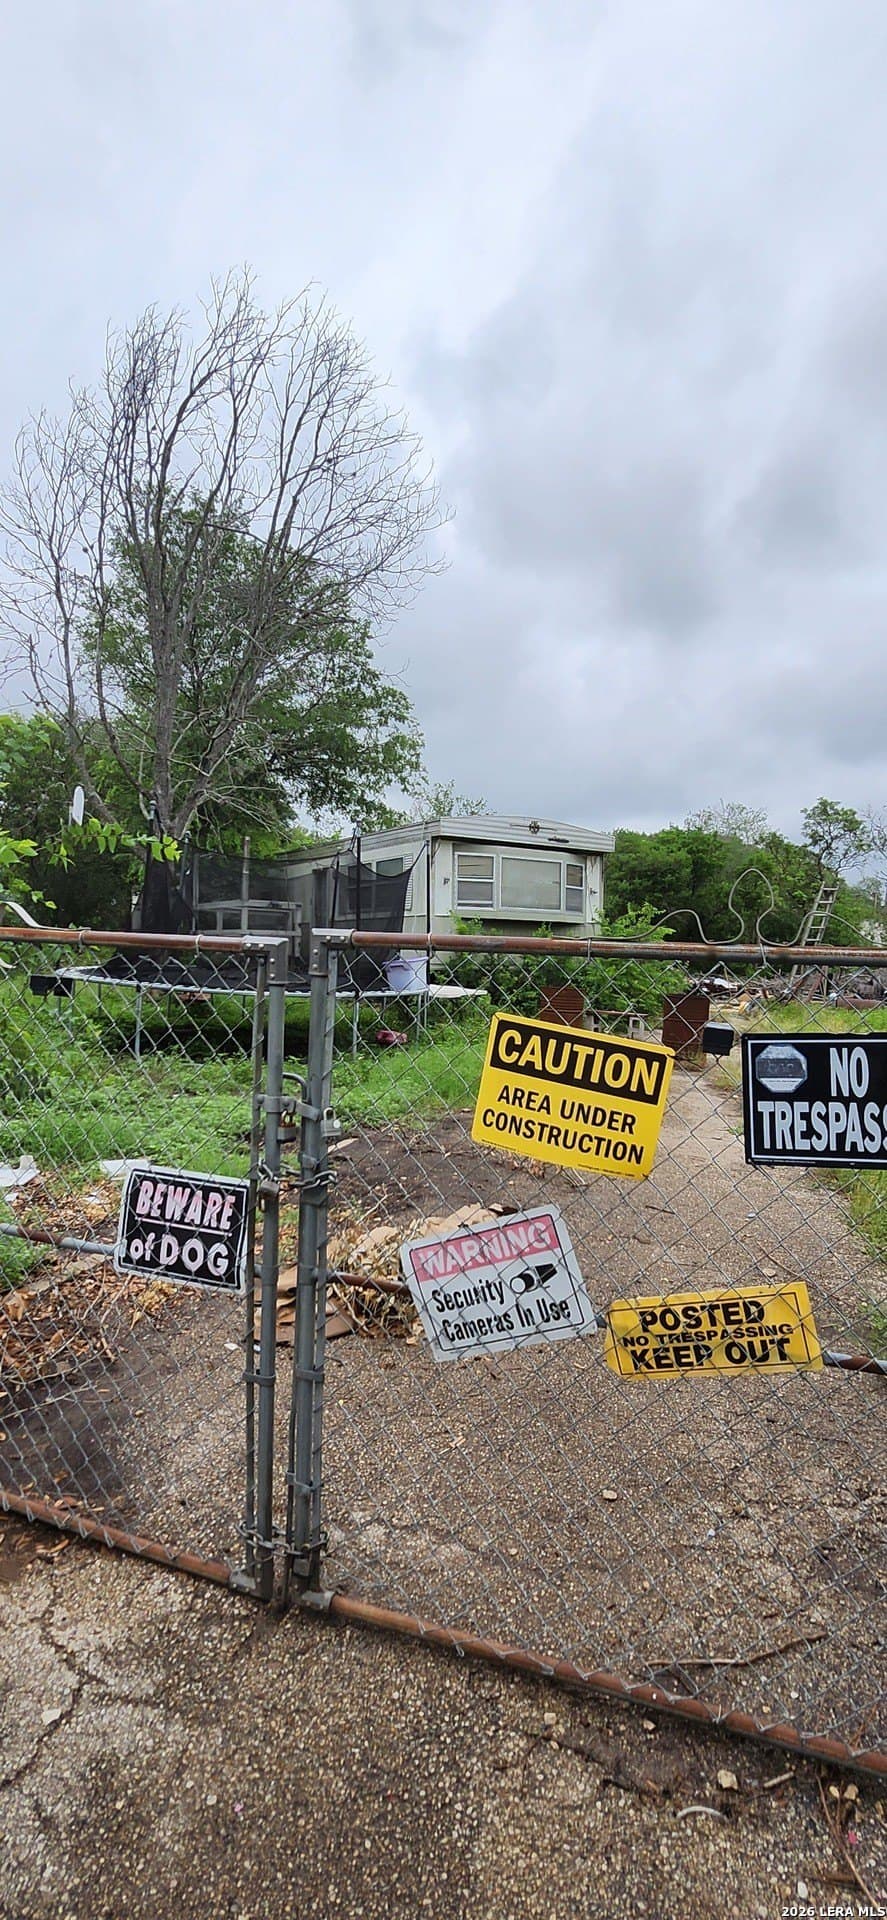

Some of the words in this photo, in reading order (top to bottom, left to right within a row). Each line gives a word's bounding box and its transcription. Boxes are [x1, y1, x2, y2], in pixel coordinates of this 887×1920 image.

[498, 1029, 660, 1096] CAUTION
[829, 1046, 869, 1098] NO
[497, 1085, 551, 1115] AREA
[560, 1099, 637, 1135] UNDER
[757, 1101, 887, 1154] TRESPAS
[482, 1108, 644, 1165] CONSTRUCTION
[136, 1180, 236, 1230] BEWARE
[130, 1232, 155, 1262] of
[159, 1233, 229, 1276] DOG
[418, 1221, 550, 1276] WARNING
[431, 1279, 505, 1313] Security
[441, 1312, 515, 1343] Cameras
[516, 1303, 534, 1328] In
[536, 1298, 571, 1324] Use
[638, 1300, 765, 1333] POSTED
[623, 1336, 649, 1348] NO
[655, 1323, 794, 1345] TRESPASSING
[632, 1344, 713, 1371] KEEP
[725, 1337, 791, 1365] OUT
